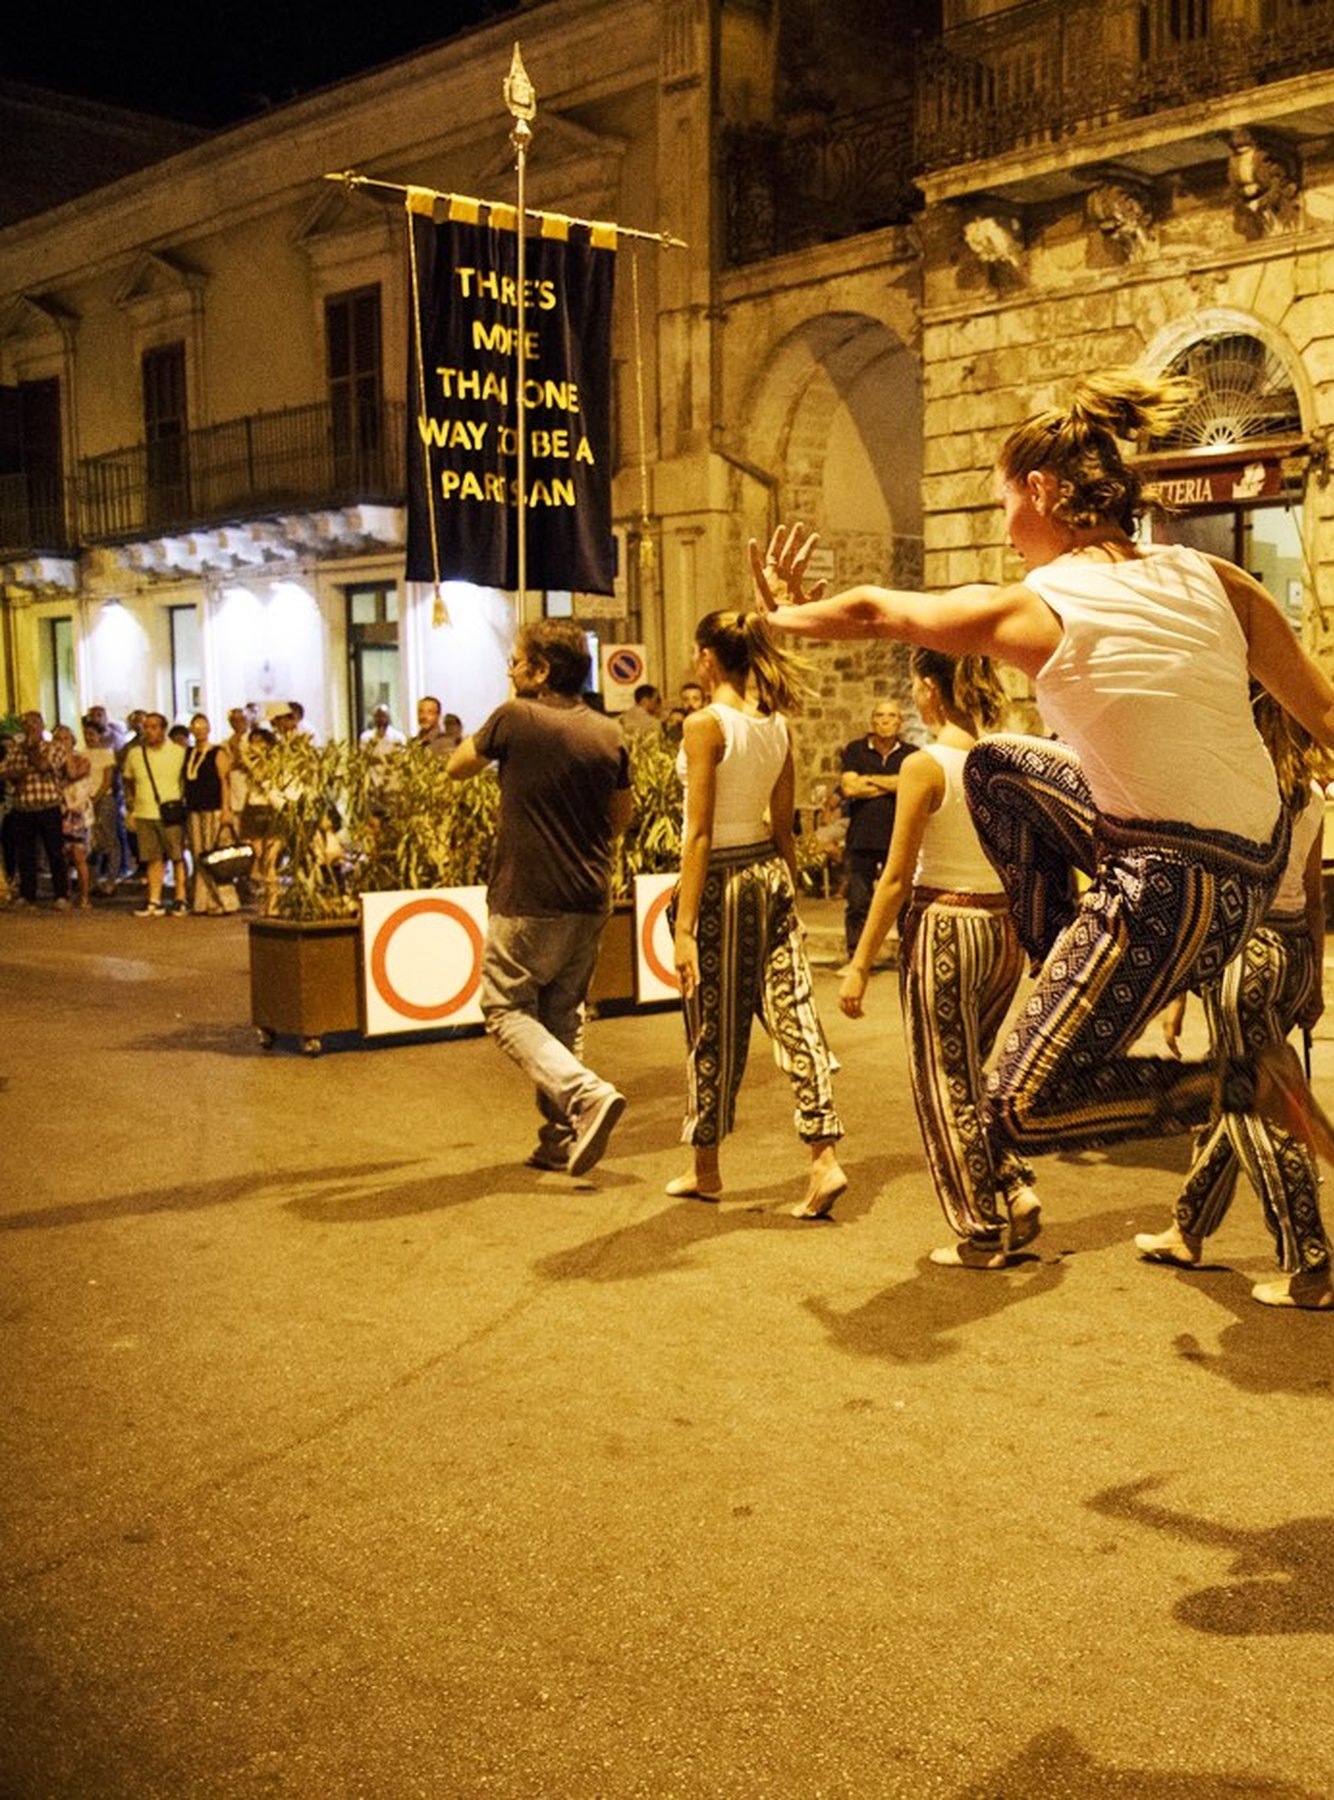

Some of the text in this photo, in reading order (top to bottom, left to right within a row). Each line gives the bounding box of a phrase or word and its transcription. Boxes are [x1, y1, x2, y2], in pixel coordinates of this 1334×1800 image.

[520, 379, 580, 413] ONE
[418, 416, 488, 450] WAY
[531, 430, 570, 458] BE
[575, 435, 595, 465] A
